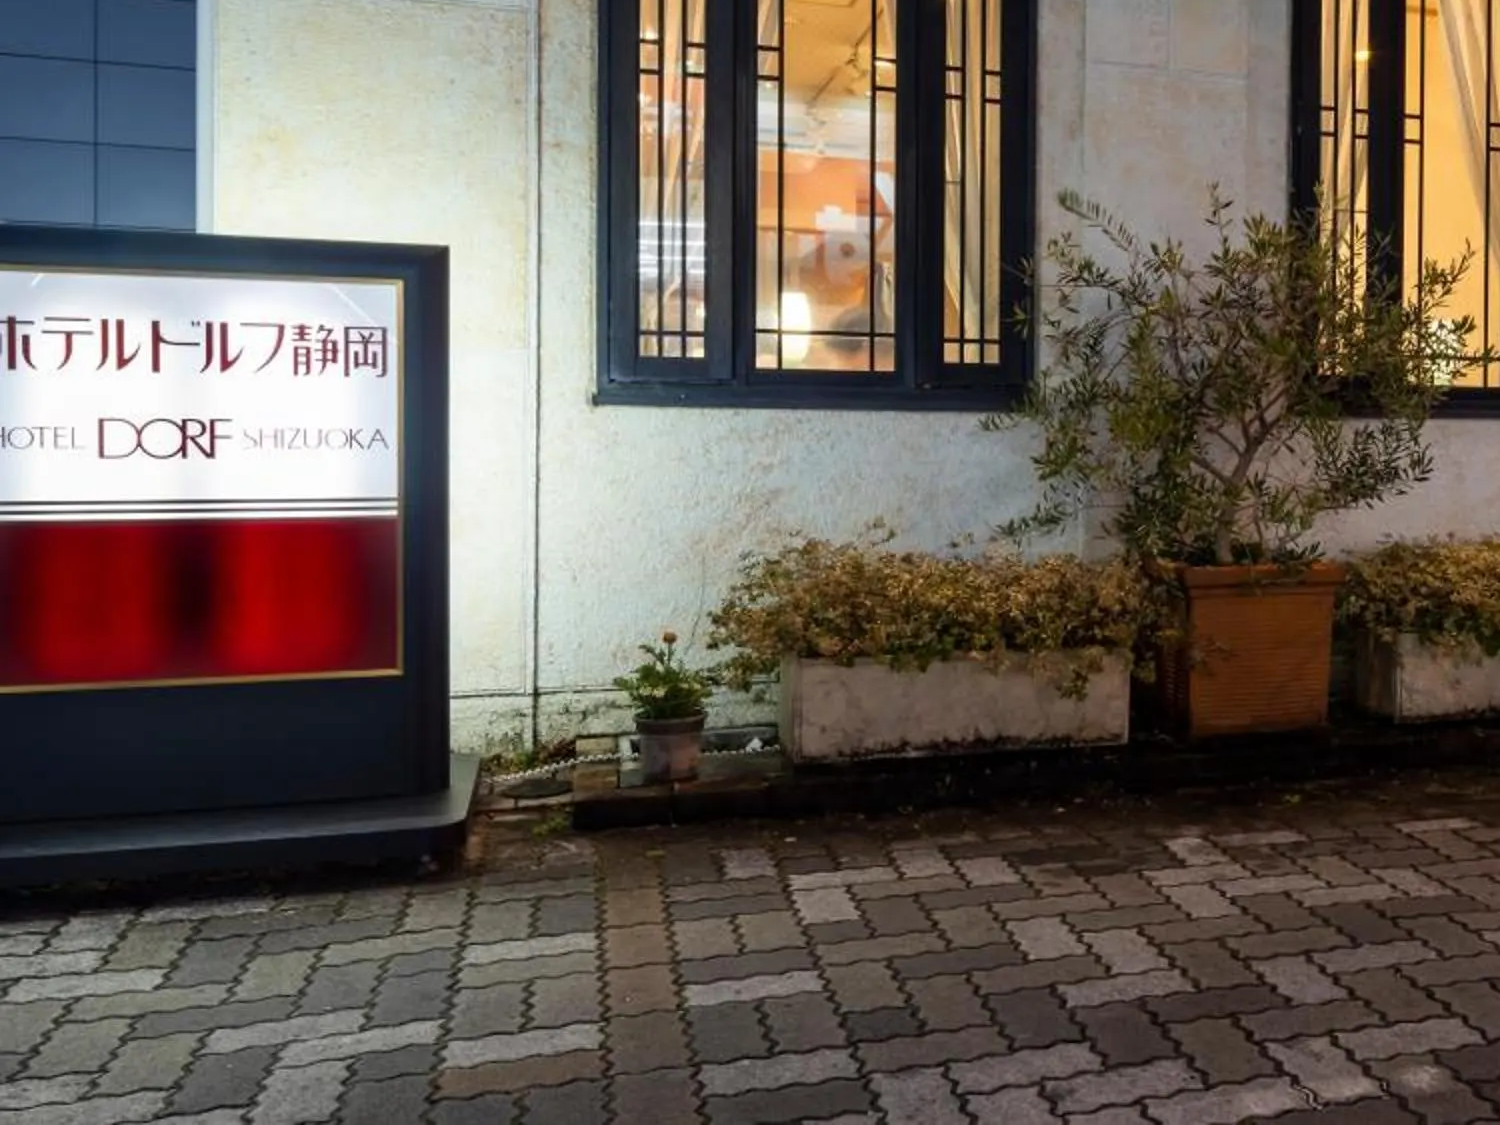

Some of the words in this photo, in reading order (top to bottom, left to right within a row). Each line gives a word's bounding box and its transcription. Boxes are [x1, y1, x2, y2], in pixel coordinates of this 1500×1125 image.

[0, 316, 388, 377] ホテルドルフ静岡
[97, 418, 233, 460] DORF
[243, 427, 389, 451] SHIZUOKA
